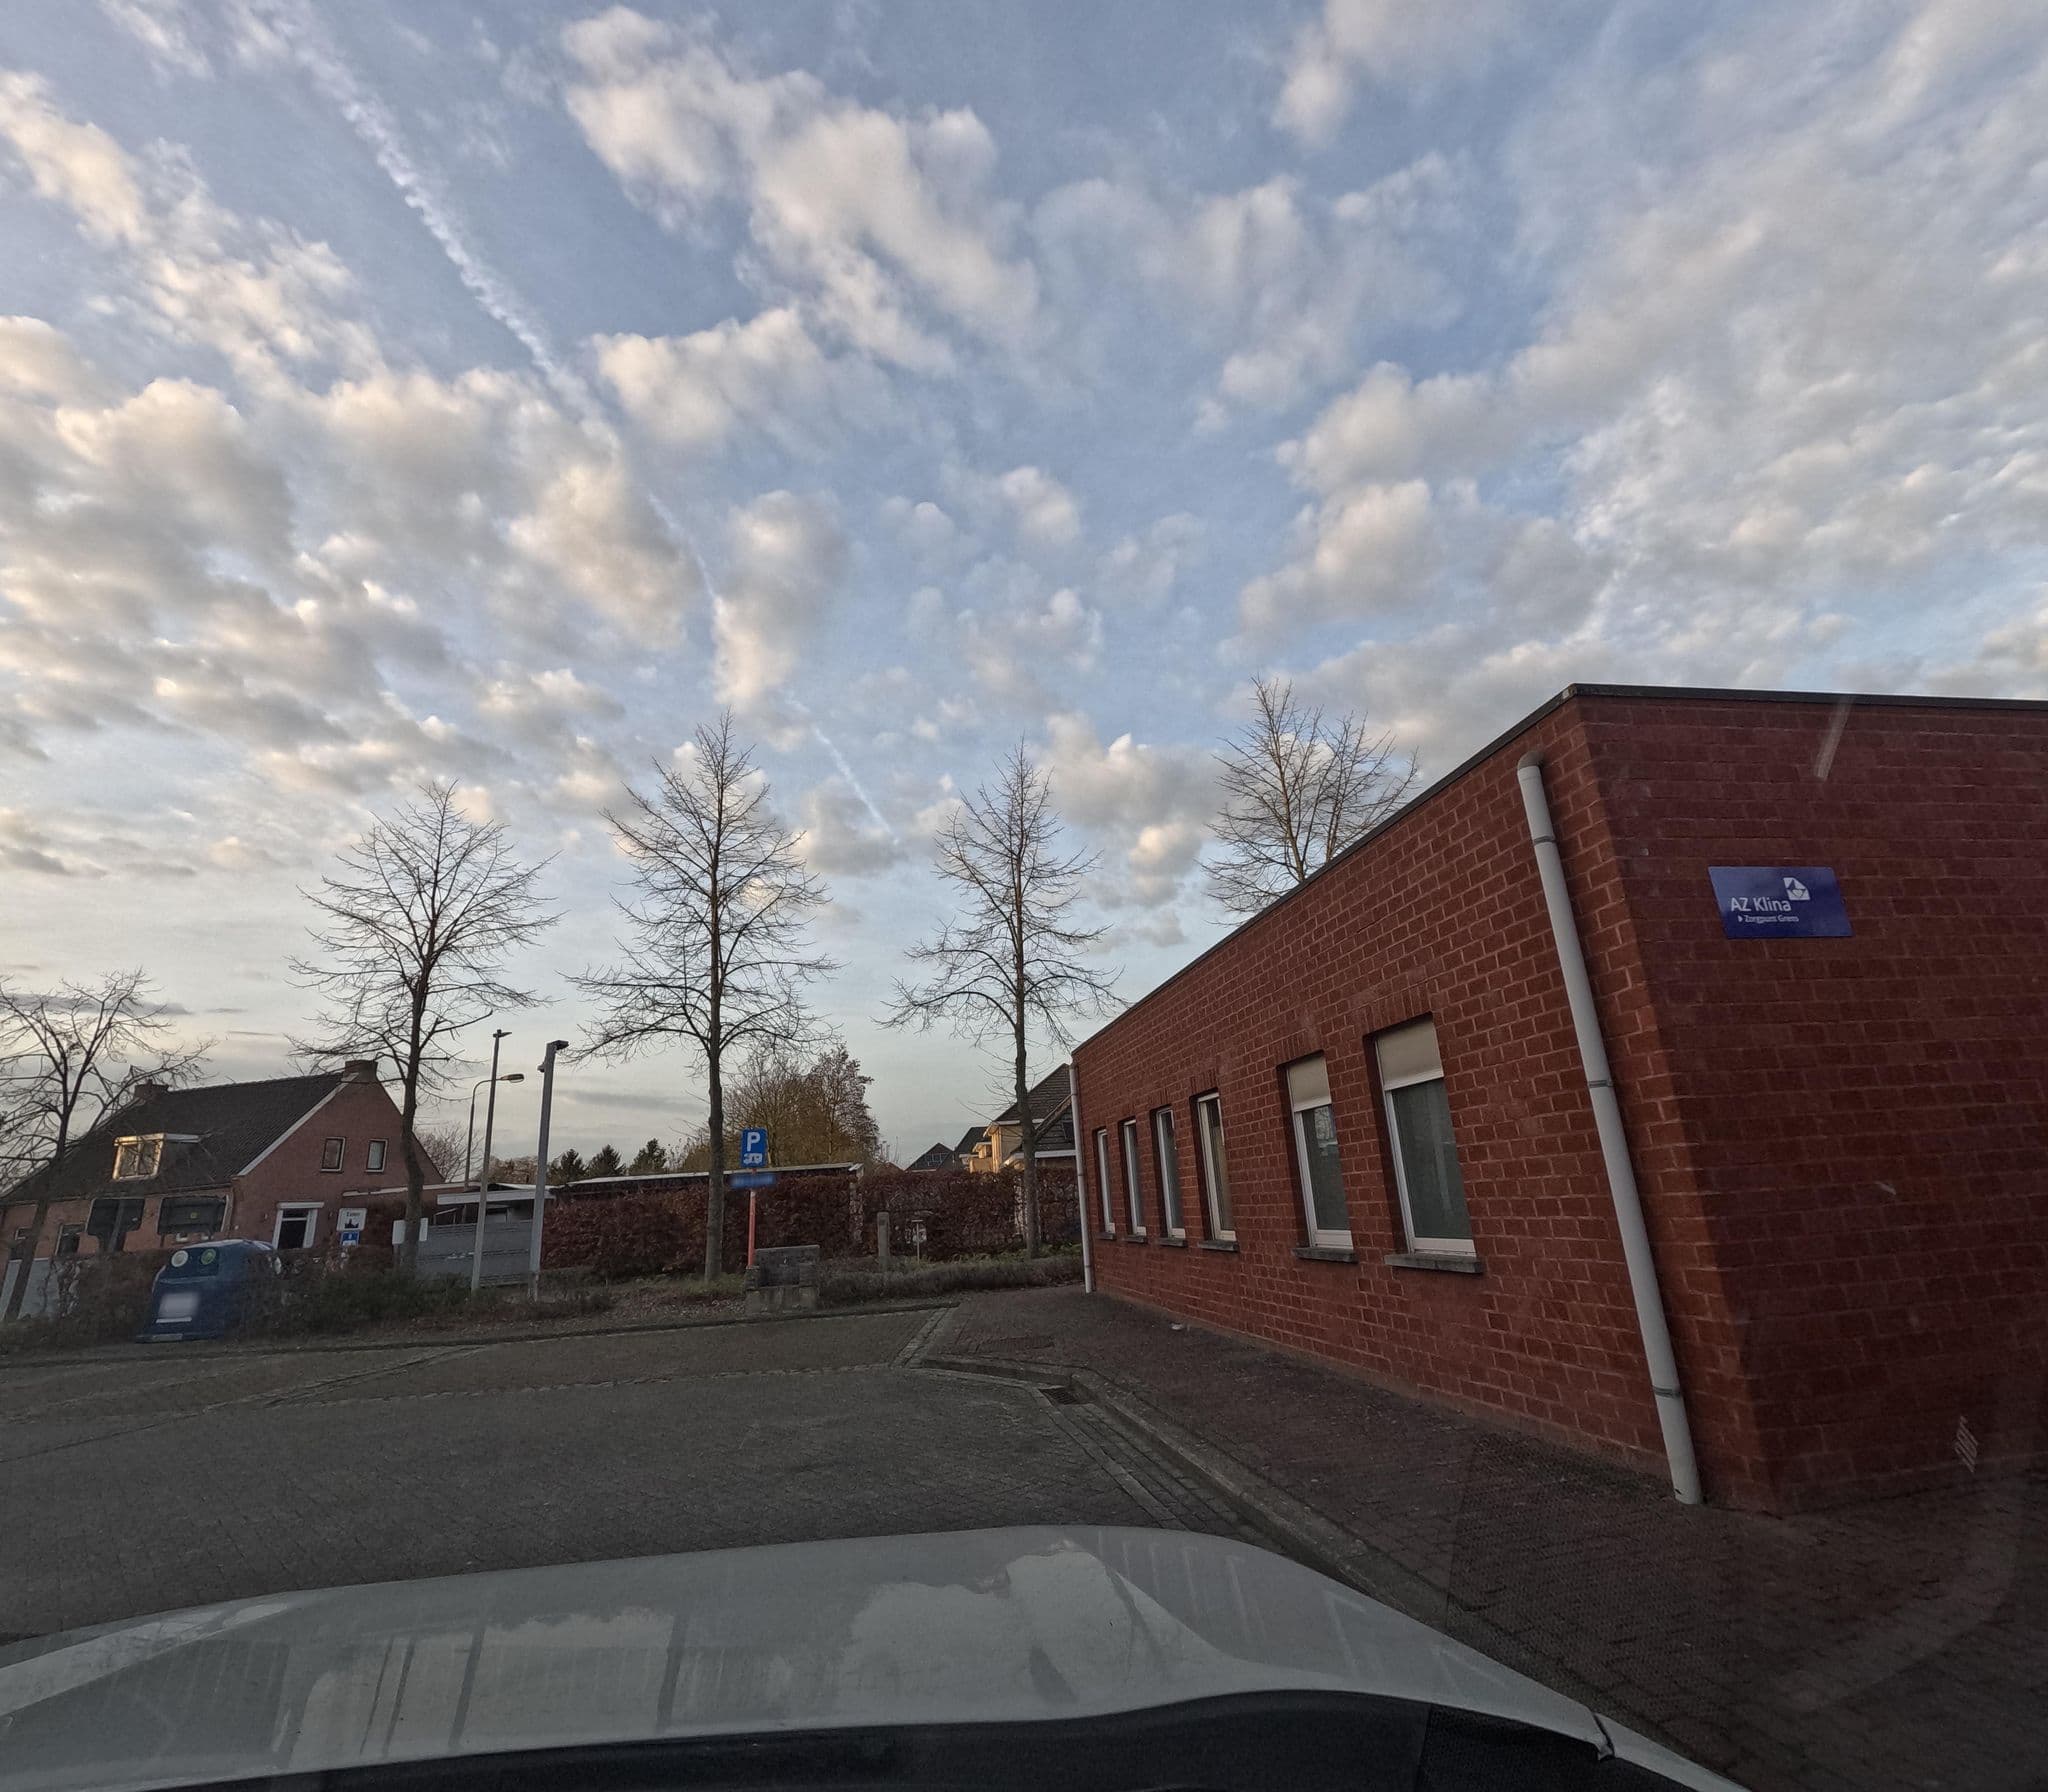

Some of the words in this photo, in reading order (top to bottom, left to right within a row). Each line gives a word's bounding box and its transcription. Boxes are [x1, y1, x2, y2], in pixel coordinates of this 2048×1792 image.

[1731, 897, 1751, 911] AZ
[1753, 896, 1792, 911] Klina
[747, 1131, 761, 1151] P
